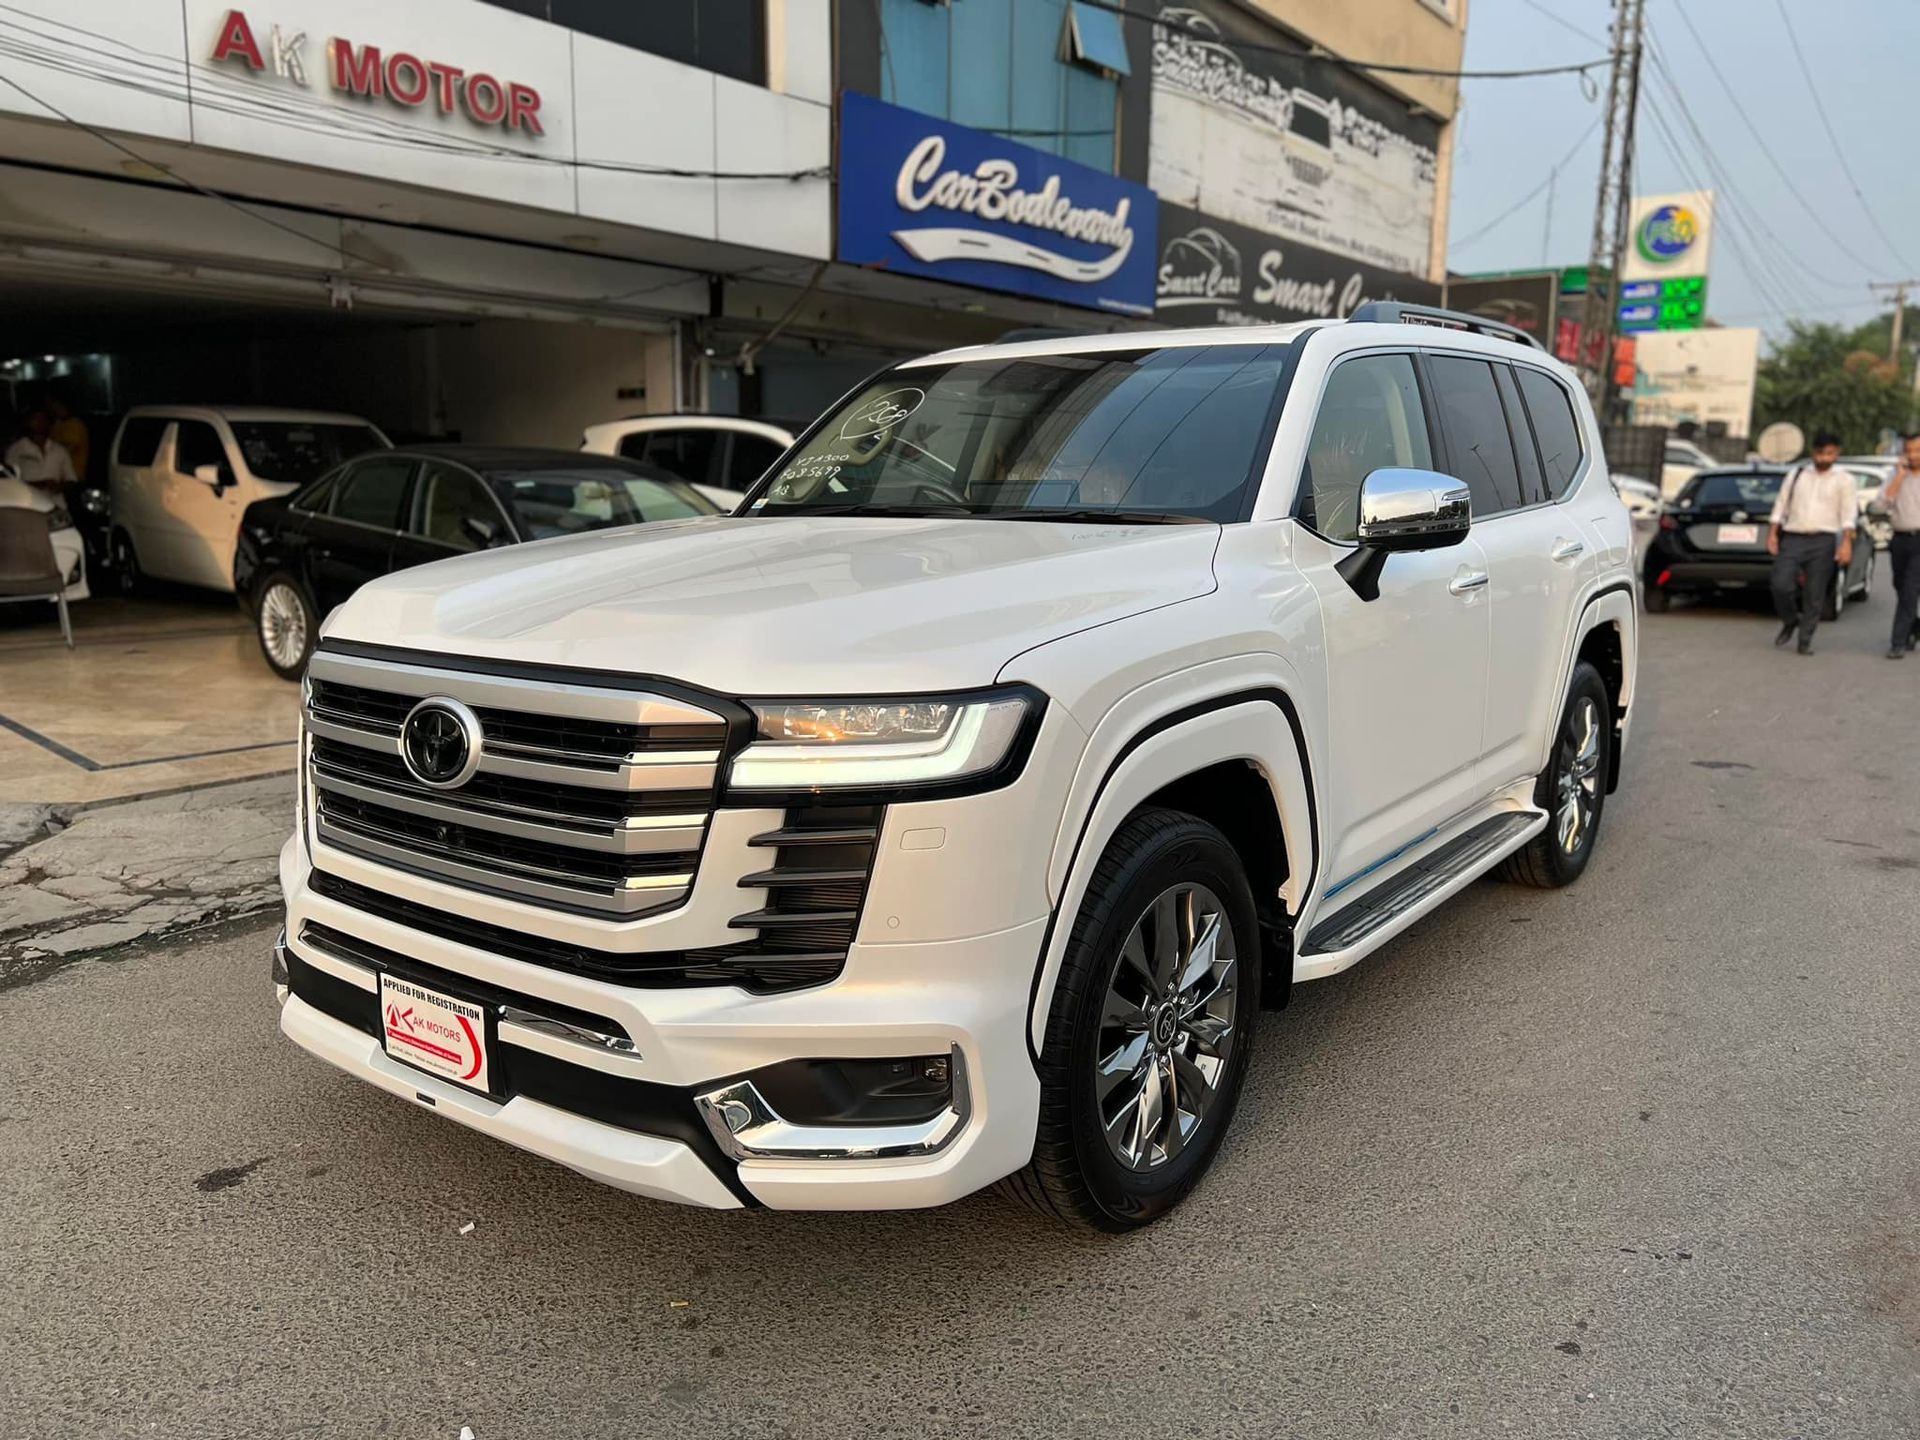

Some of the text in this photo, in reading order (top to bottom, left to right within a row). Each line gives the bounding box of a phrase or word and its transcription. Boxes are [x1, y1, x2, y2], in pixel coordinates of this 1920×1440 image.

[328, 37, 545, 136] MOTOR
[1252, 249, 1336, 317] Smart
[383, 978, 480, 1020] APPLIED FOR REGISTRATION
[413, 1016, 425, 1030] AK
[427, 1022, 461, 1042] MOTORS
